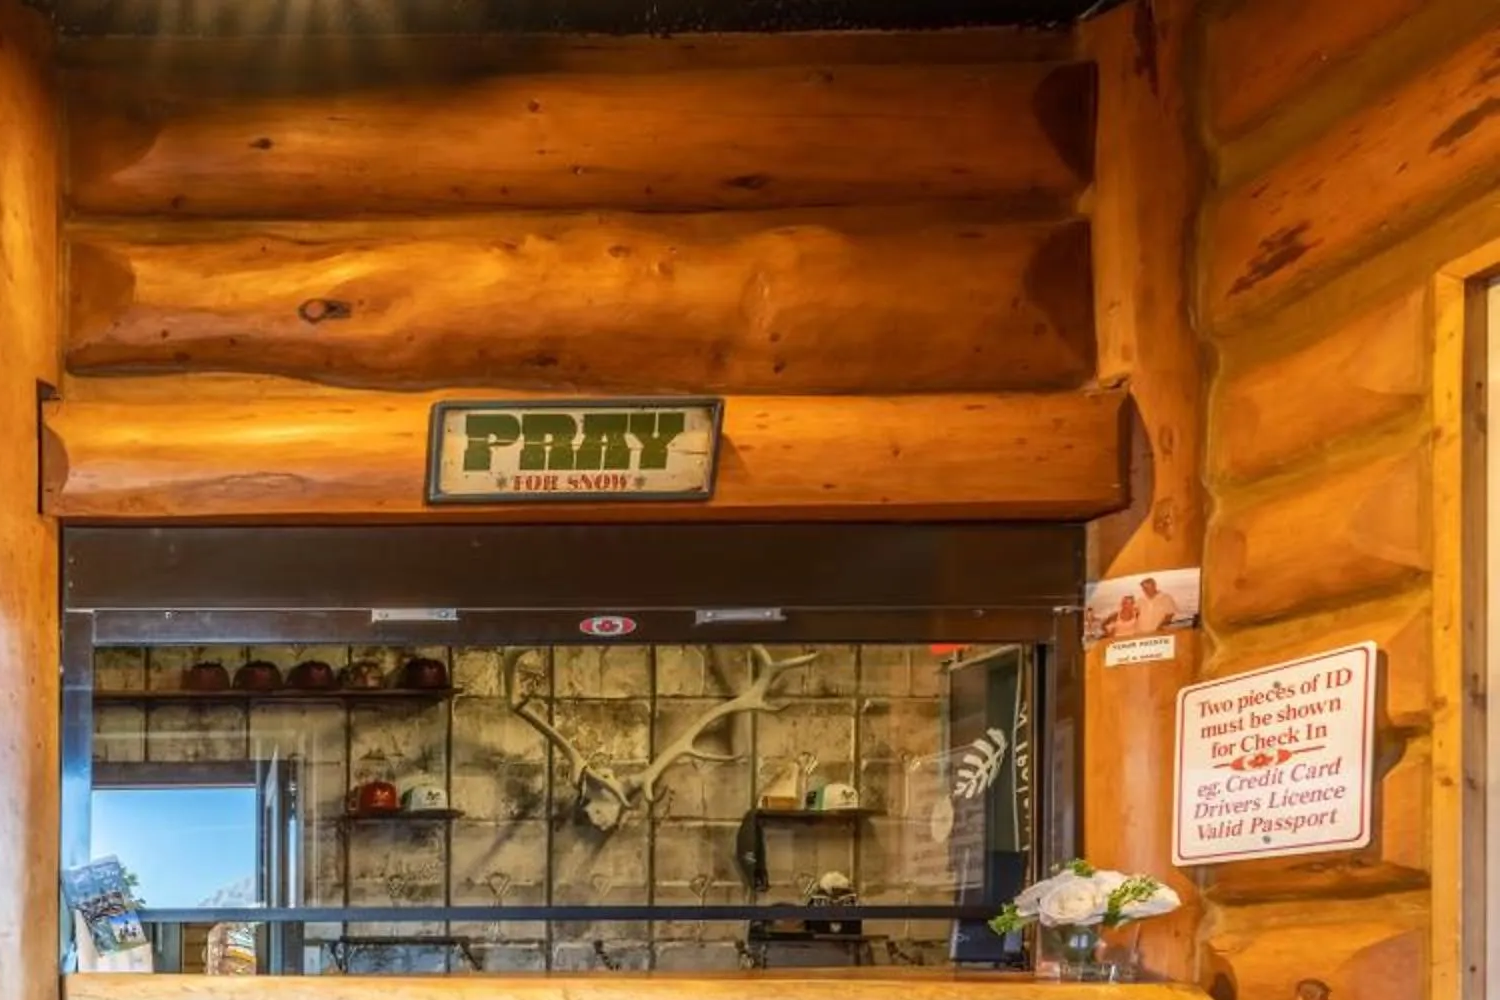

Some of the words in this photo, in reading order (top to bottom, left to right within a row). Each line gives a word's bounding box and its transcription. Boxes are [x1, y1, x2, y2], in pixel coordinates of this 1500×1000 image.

[463, 413, 685, 470] PRAY
[513, 475, 558, 490] FOR
[567, 474, 629, 490] SNOW
[1198, 697, 1234, 719] Two
[1237, 684, 1296, 712] pieces
[1300, 673, 1321, 696] of
[1326, 667, 1354, 689] ID
[1201, 718, 1245, 740] must
[1250, 708, 1273, 728] be
[1276, 696, 1342, 723] shown
[1211, 740, 1238, 760] for
[1240, 727, 1300, 754] Check
[1306, 722, 1328, 741] In
[1226, 768, 1284, 795] Credit
[1290, 756, 1343, 782] Card
[1193, 796, 1262, 820] Drivers
[1268, 783, 1347, 809] Licence
[1197, 818, 1244, 842] Valid
[1250, 807, 1338, 834] Passport
